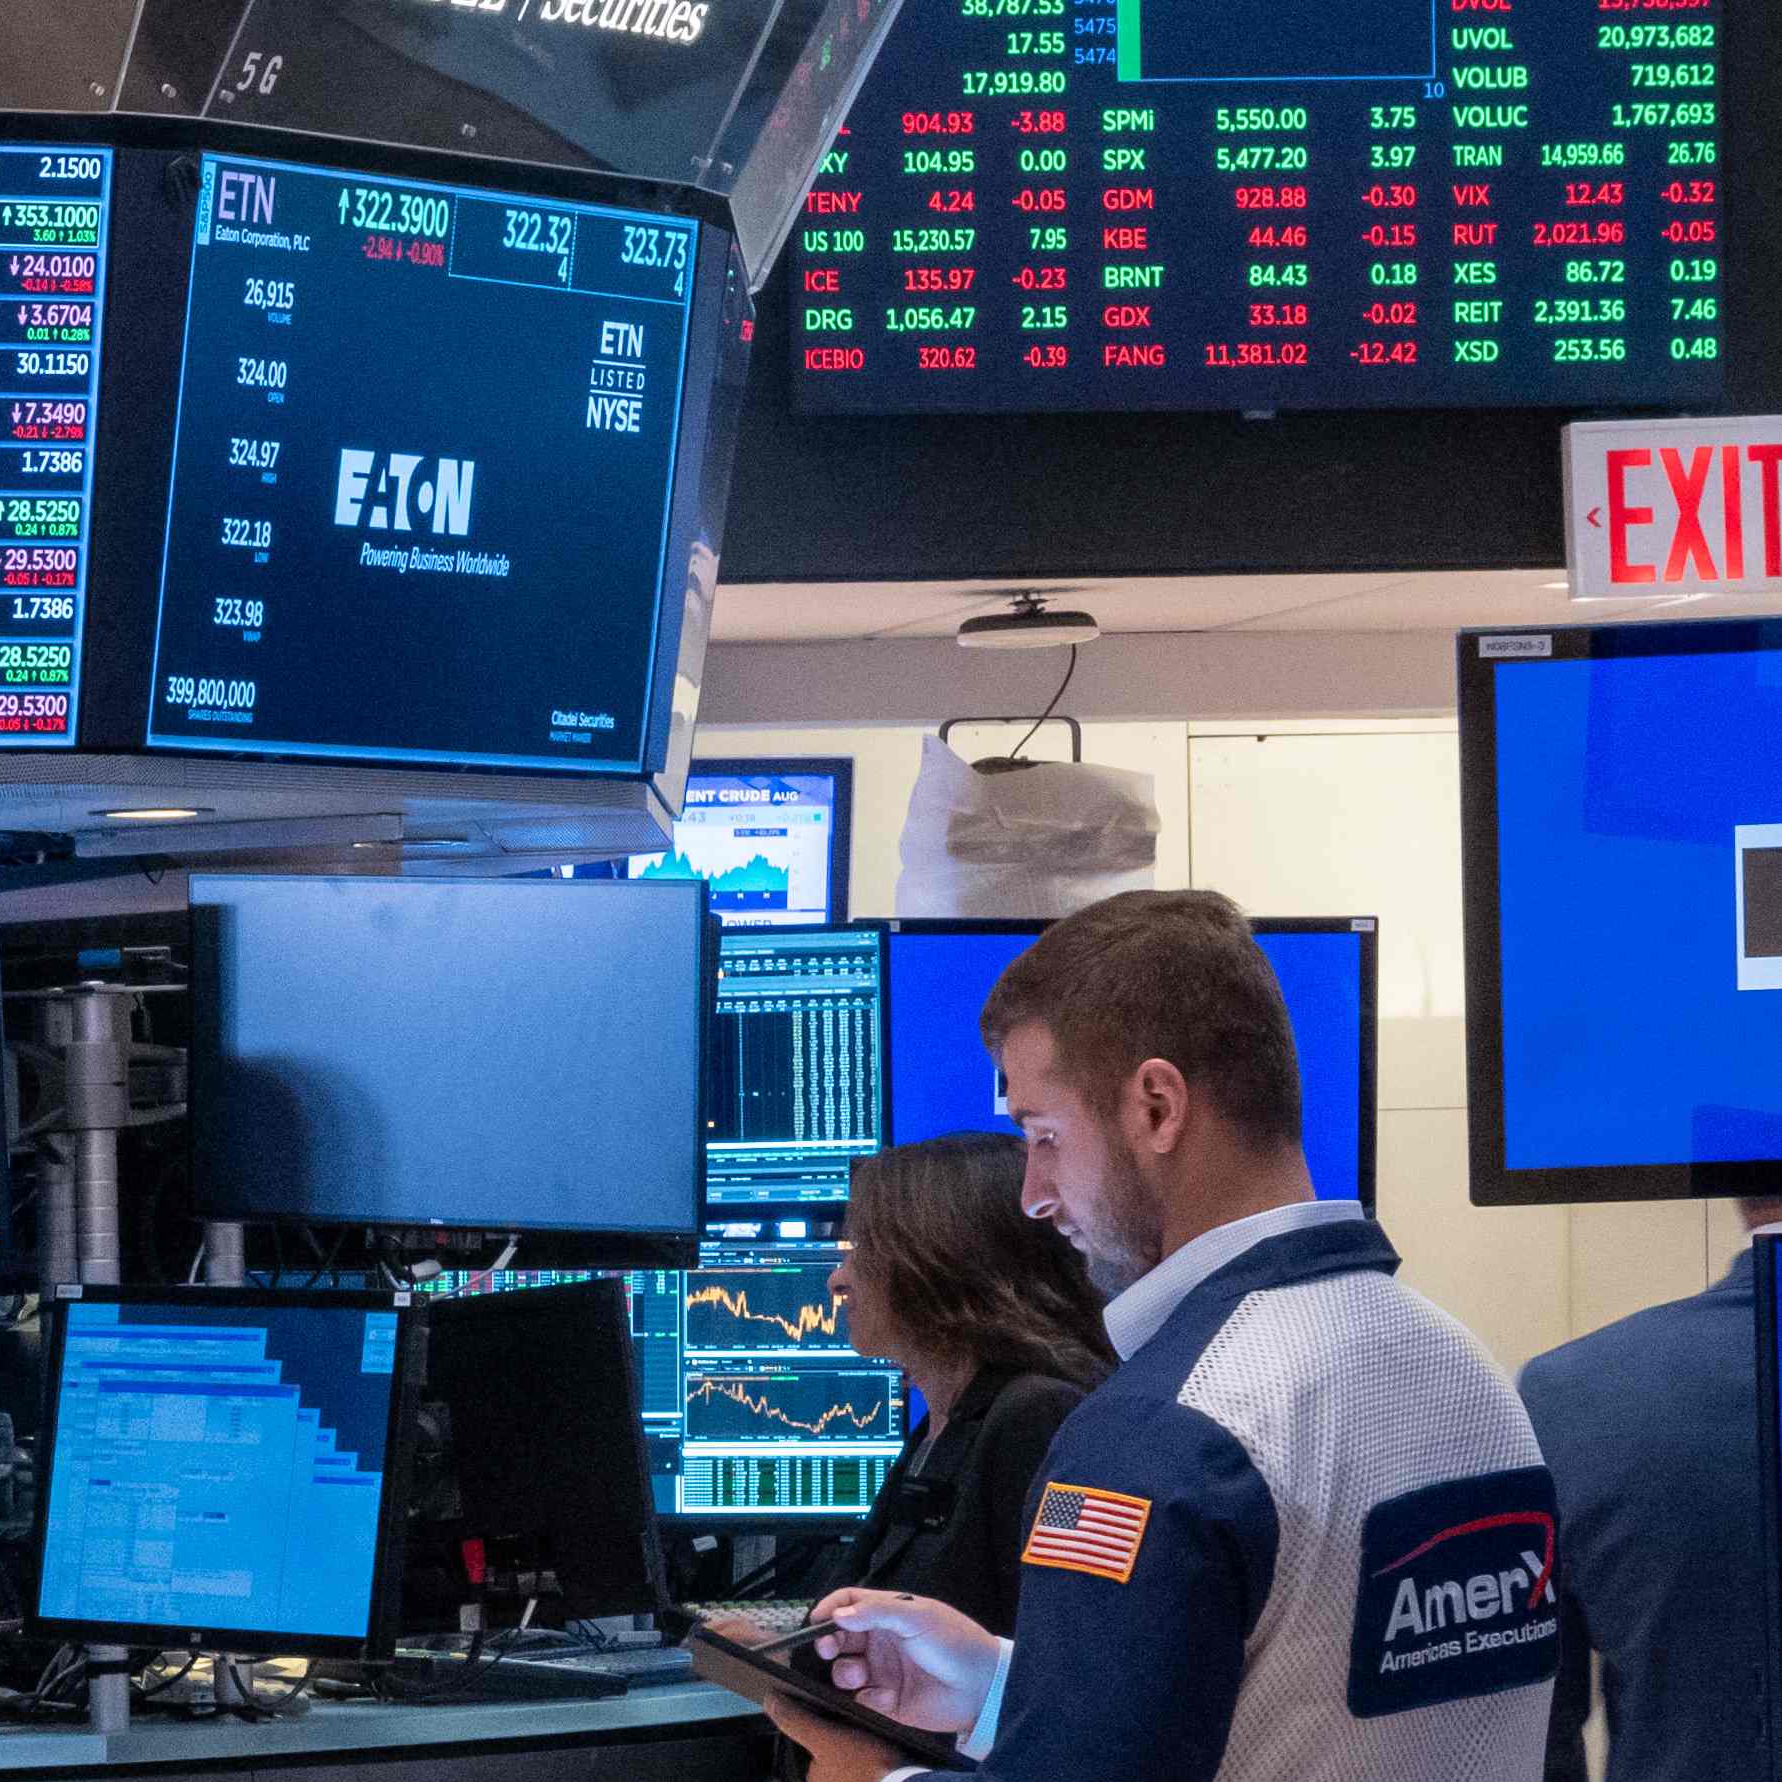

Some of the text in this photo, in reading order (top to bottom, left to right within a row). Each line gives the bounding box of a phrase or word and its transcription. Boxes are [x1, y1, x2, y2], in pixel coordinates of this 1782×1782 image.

[961, 25, 1715, 98] 17,919.80 20,973,682
[1102, 145, 1307, 173] SPX 5,477.20
[218, 171, 687, 269] ETN 322.3900 322.32 323.73
[216, 229, 310, 252] Eaton Corporation, PLC
[23, 255, 94, 278] 24.0100
[804, 267, 975, 292] ICE 135.97
[244, 278, 295, 310] 26,915
[601, 321, 644, 358] ETN
[1104, 337, 1626, 368] FANG 11,381.02 -12.42 XSD 253.56
[237, 359, 287, 388] 324.00
[591, 367, 645, 390] LISTED
[587, 396, 643, 433] NYSE
[230, 438, 280, 468] 324.97
[335, 448, 474, 535] EATON
[1606, 444, 1782, 584] EXIT
[222, 518, 271, 548] 322.18
[361, 543, 510, 576] Powering Business Worldwide
[214, 598, 263, 627] 323.98
[166, 676, 255, 708] 399,800,000
[552, 711, 615, 729] Citadel Securities
[719, 790, 770, 802] CRUDE
[773, 792, 798, 801] AUG
[1381, 1617, 1557, 1674] Americas Executions
